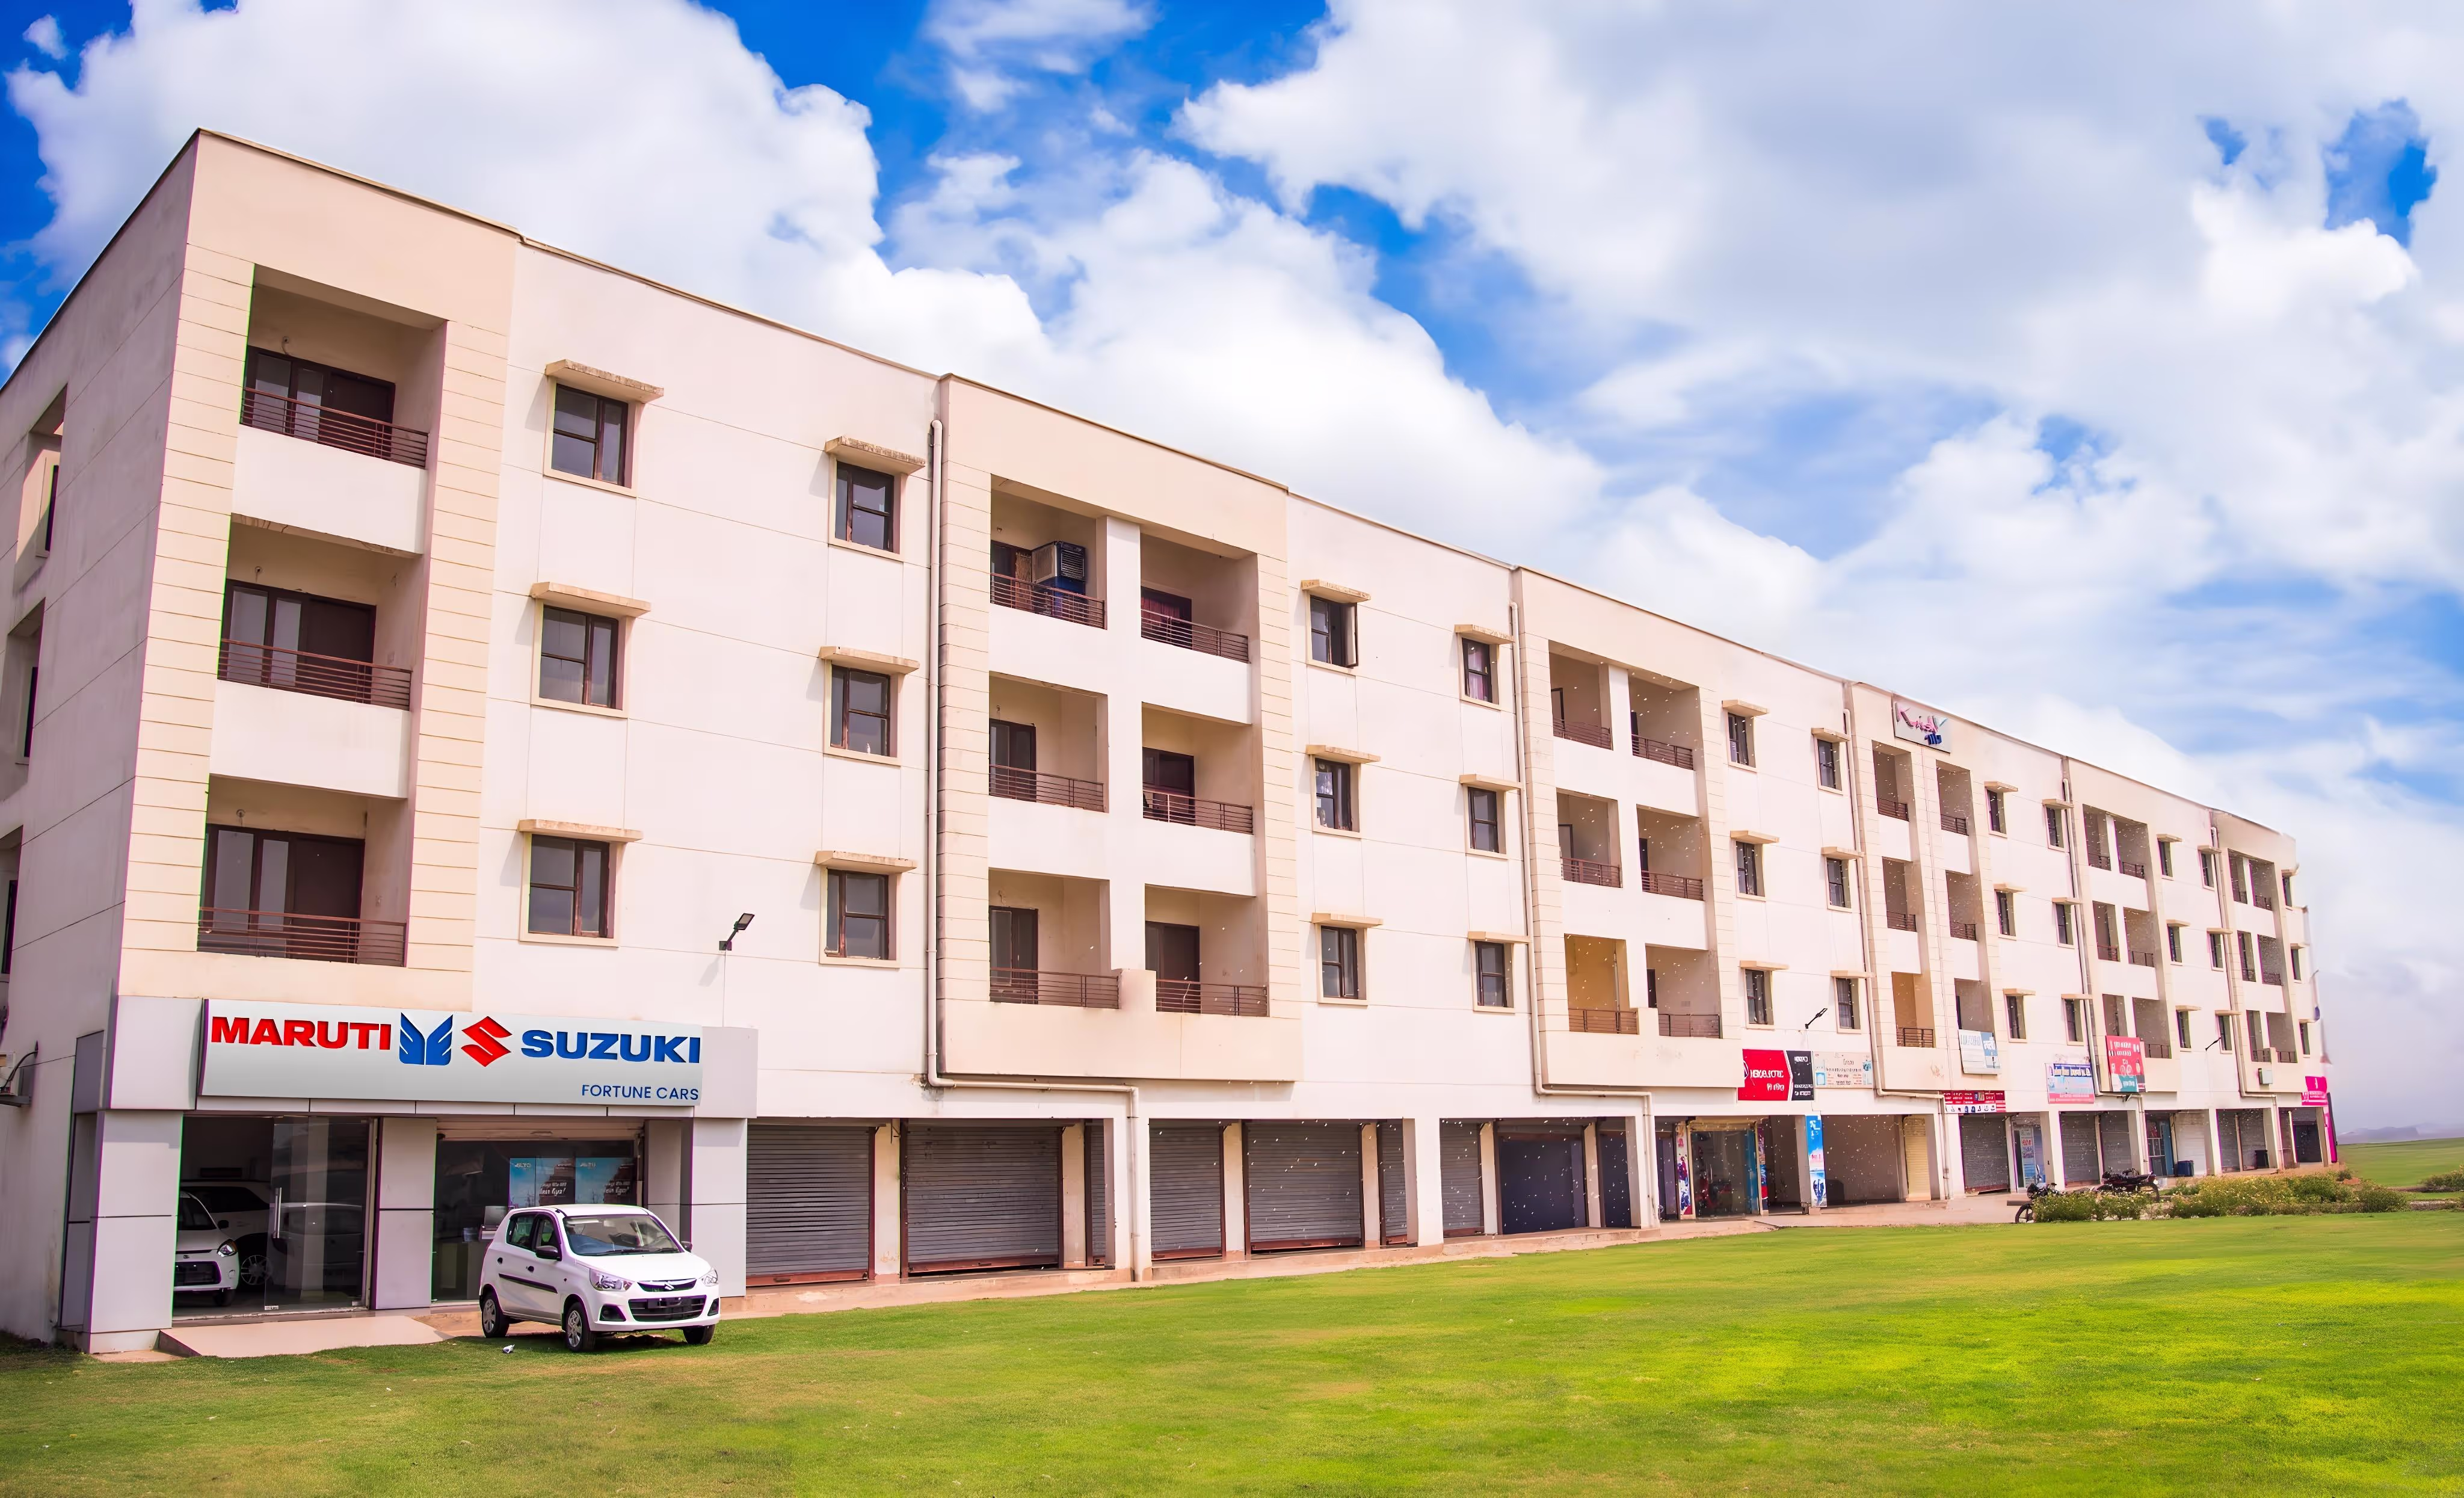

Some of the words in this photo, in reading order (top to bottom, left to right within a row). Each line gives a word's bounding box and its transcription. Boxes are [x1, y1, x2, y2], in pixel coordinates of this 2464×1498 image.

[211, 1017, 390, 1050] MARUTI
[522, 1030, 700, 1063] SUZUKI
[582, 1084, 651, 1099] FORTUNE
[656, 1087, 698, 1100] CARS
